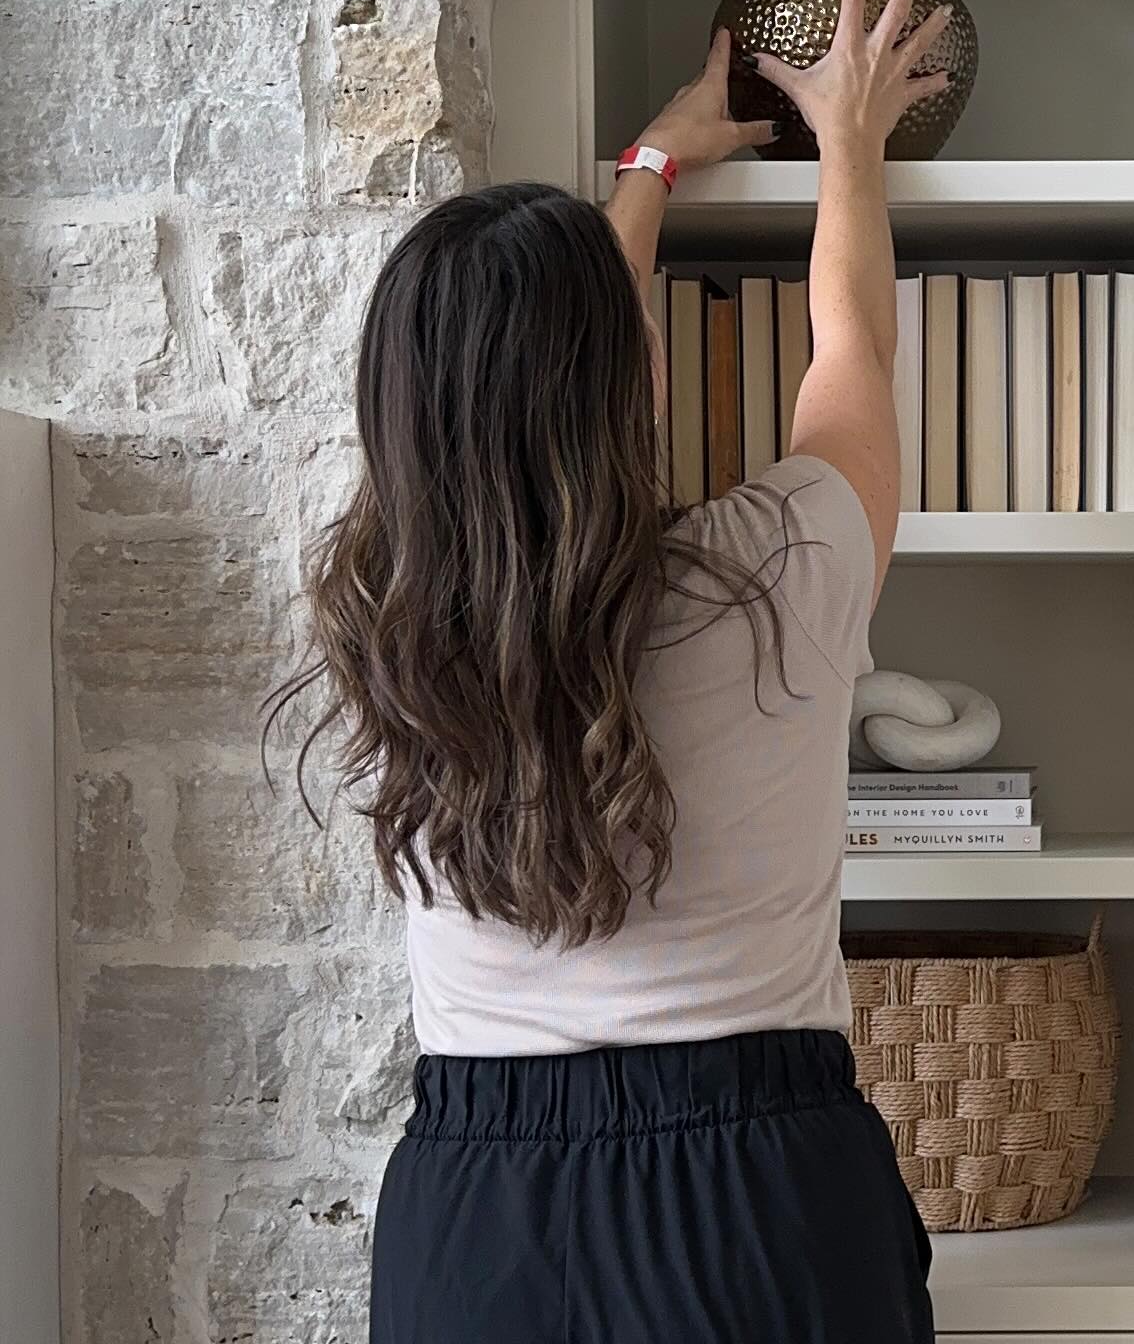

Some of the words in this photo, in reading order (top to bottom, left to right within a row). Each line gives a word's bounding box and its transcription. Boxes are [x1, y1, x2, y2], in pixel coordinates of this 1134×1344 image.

[858, 783, 887, 792] Interior
[889, 783, 916, 793] Design
[918, 783, 959, 792] Handbook
[894, 834, 963, 844] MYQUILLYN
[967, 834, 1004, 844] SMITH
